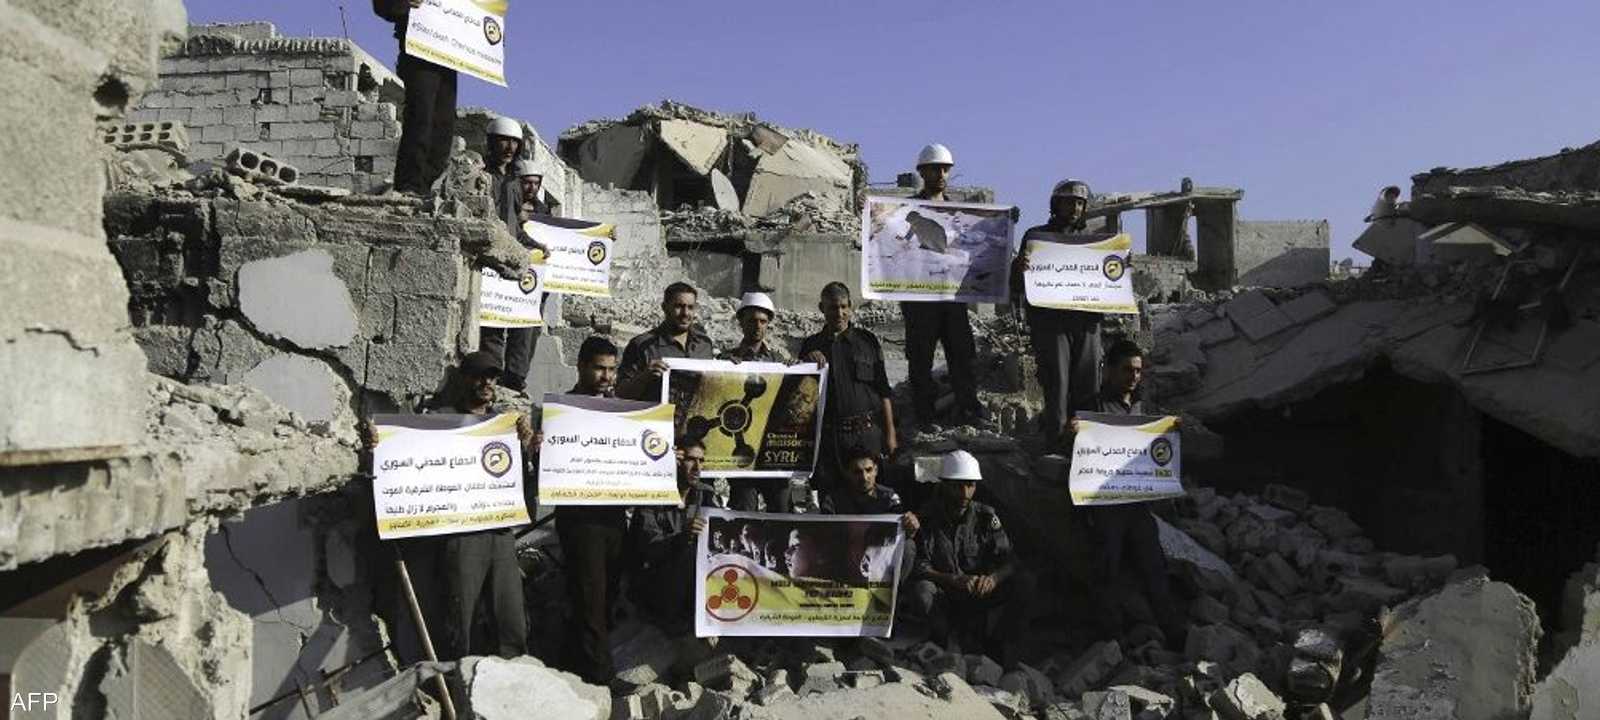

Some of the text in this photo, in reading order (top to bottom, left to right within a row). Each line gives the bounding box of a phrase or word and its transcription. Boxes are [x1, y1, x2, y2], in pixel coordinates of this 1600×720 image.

[1055, 263, 1078, 273] المدني
[1080, 264, 1101, 274] الدفاع
[547, 434, 637, 448] الدفاع المدني السوري
[1101, 447, 1125, 457] المدني
[380, 456, 477, 471] الدفاع المدني السوري
